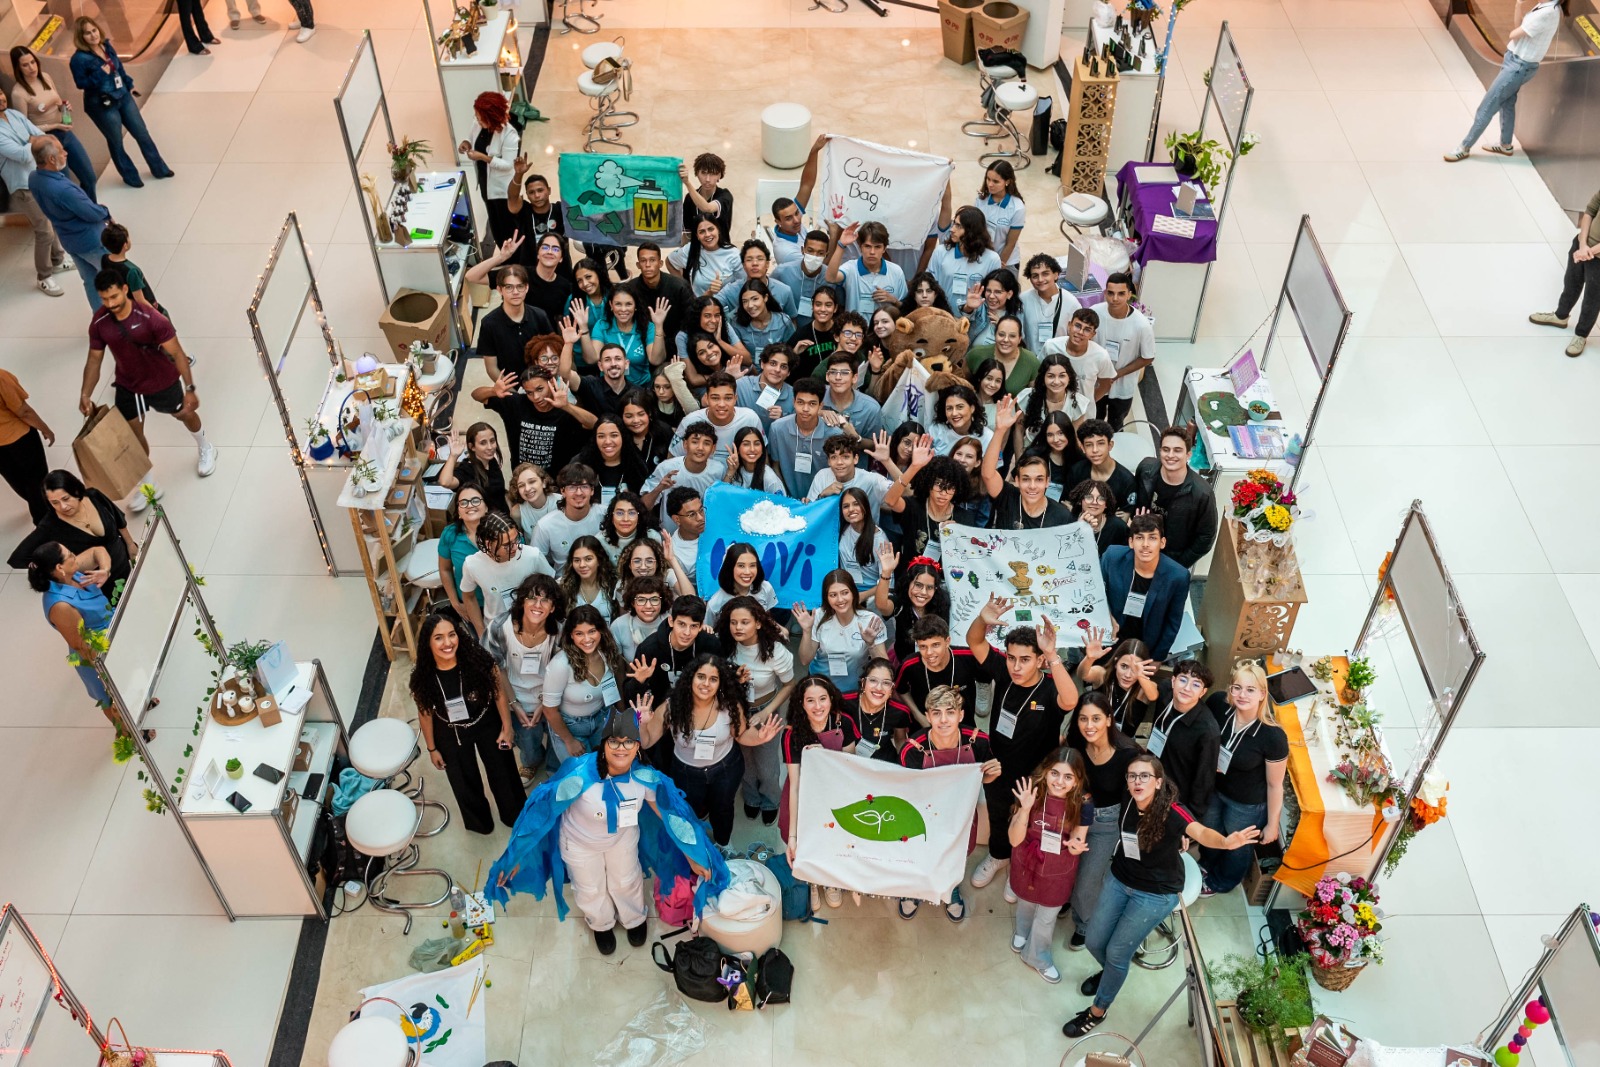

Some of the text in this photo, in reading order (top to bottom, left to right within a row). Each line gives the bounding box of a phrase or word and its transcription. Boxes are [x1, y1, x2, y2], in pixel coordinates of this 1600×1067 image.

[843, 156, 892, 189] Calm
[849, 182, 879, 212] Bag
[638, 202, 663, 228] AM
[710, 538, 816, 592] Vi
[994, 594, 1060, 608] PSART
